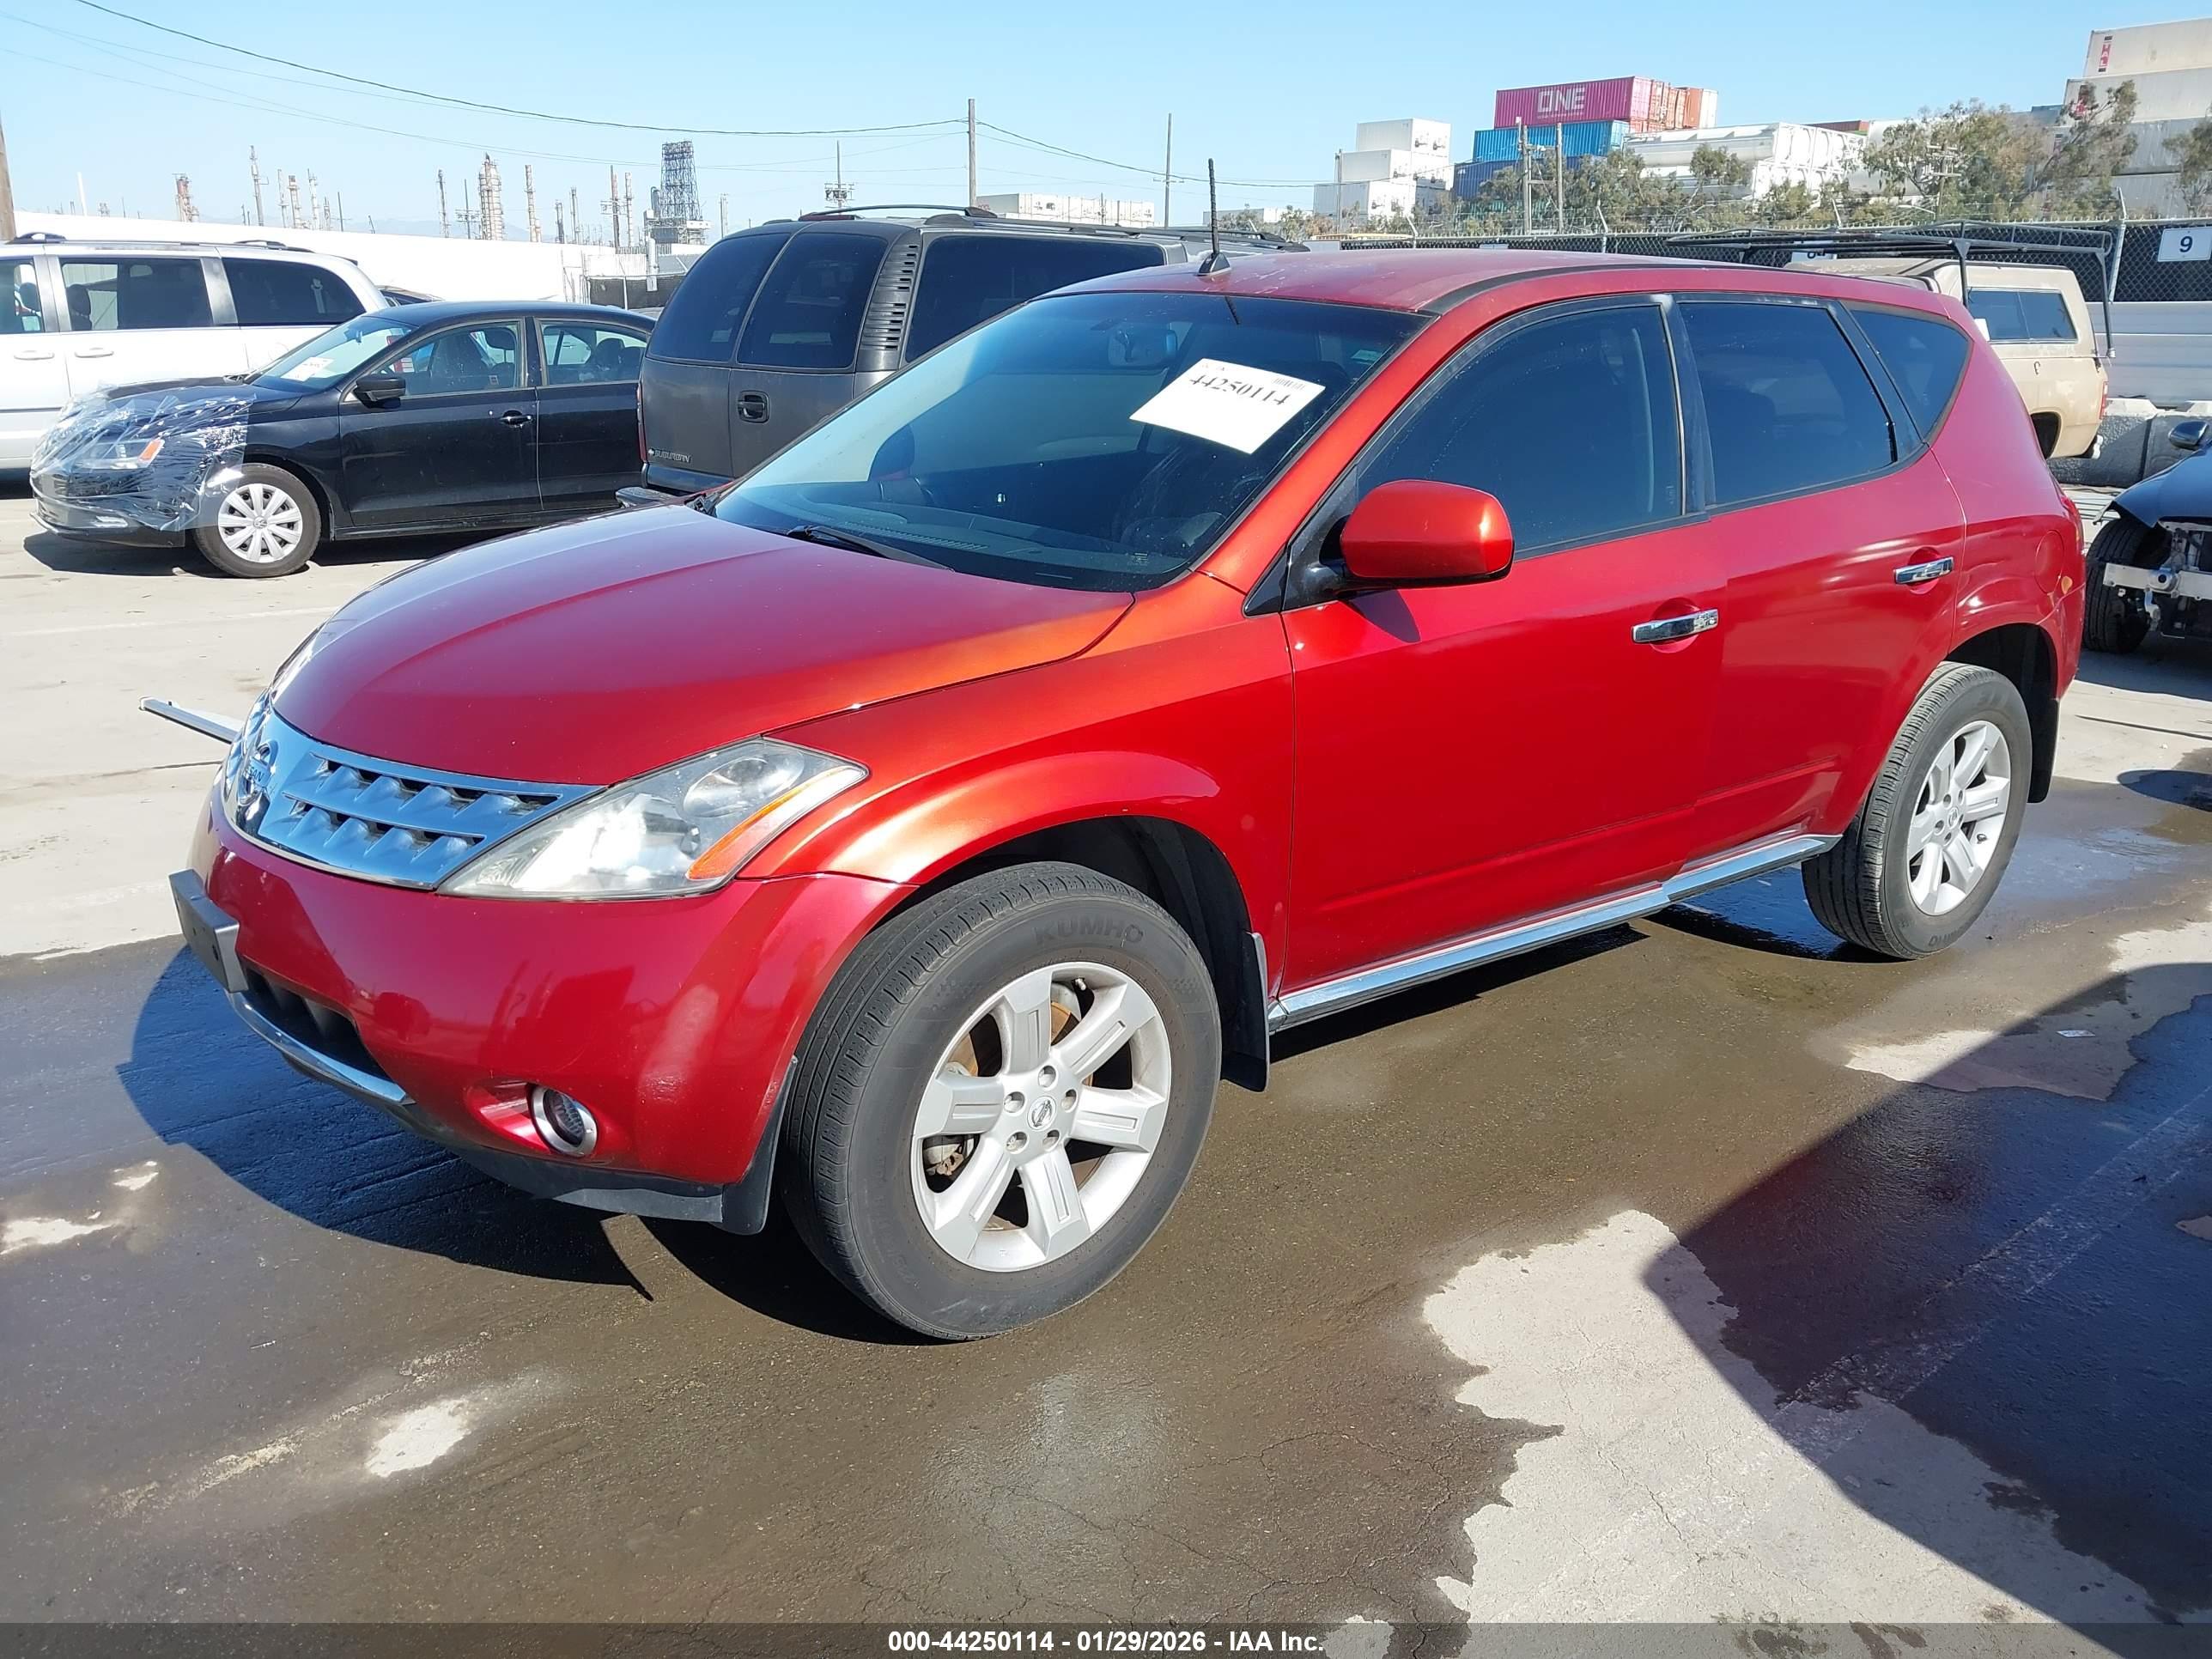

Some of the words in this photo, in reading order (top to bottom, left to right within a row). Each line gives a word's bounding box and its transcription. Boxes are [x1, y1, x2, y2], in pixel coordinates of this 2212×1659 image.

[1537, 87, 1585, 112] ONE
[2179, 235, 2193, 252] 9
[1189, 374, 1291, 406] 44250114
[654, 449, 691, 463] SUBURBAN
[1034, 913, 1145, 945] KUMHO
